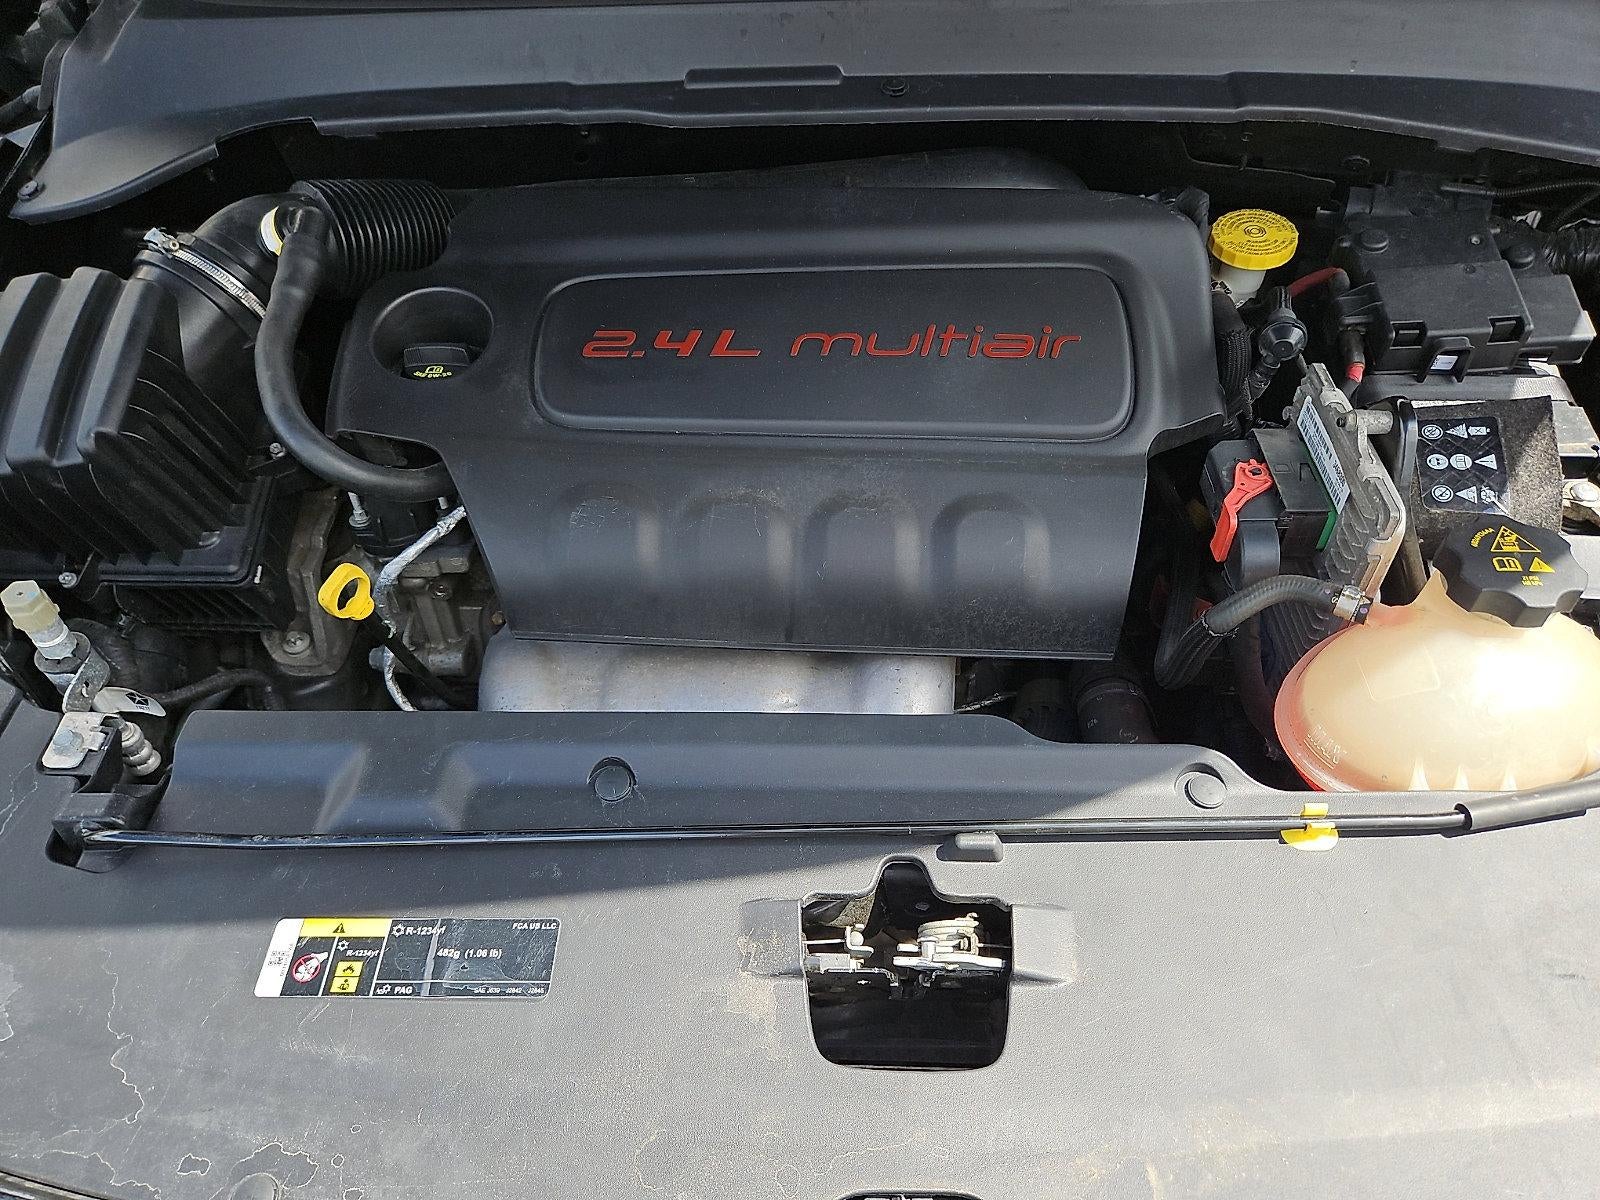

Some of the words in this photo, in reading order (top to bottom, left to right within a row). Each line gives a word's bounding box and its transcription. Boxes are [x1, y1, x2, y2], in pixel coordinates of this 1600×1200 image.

[789, 323, 1082, 359] multiair
[405, 925, 446, 936] R-1234yf
[512, 922, 530, 930] FCA
[541, 922, 558, 930] LLC
[345, 949, 380, 958] R-1234yf
[394, 986, 413, 995] PAG
